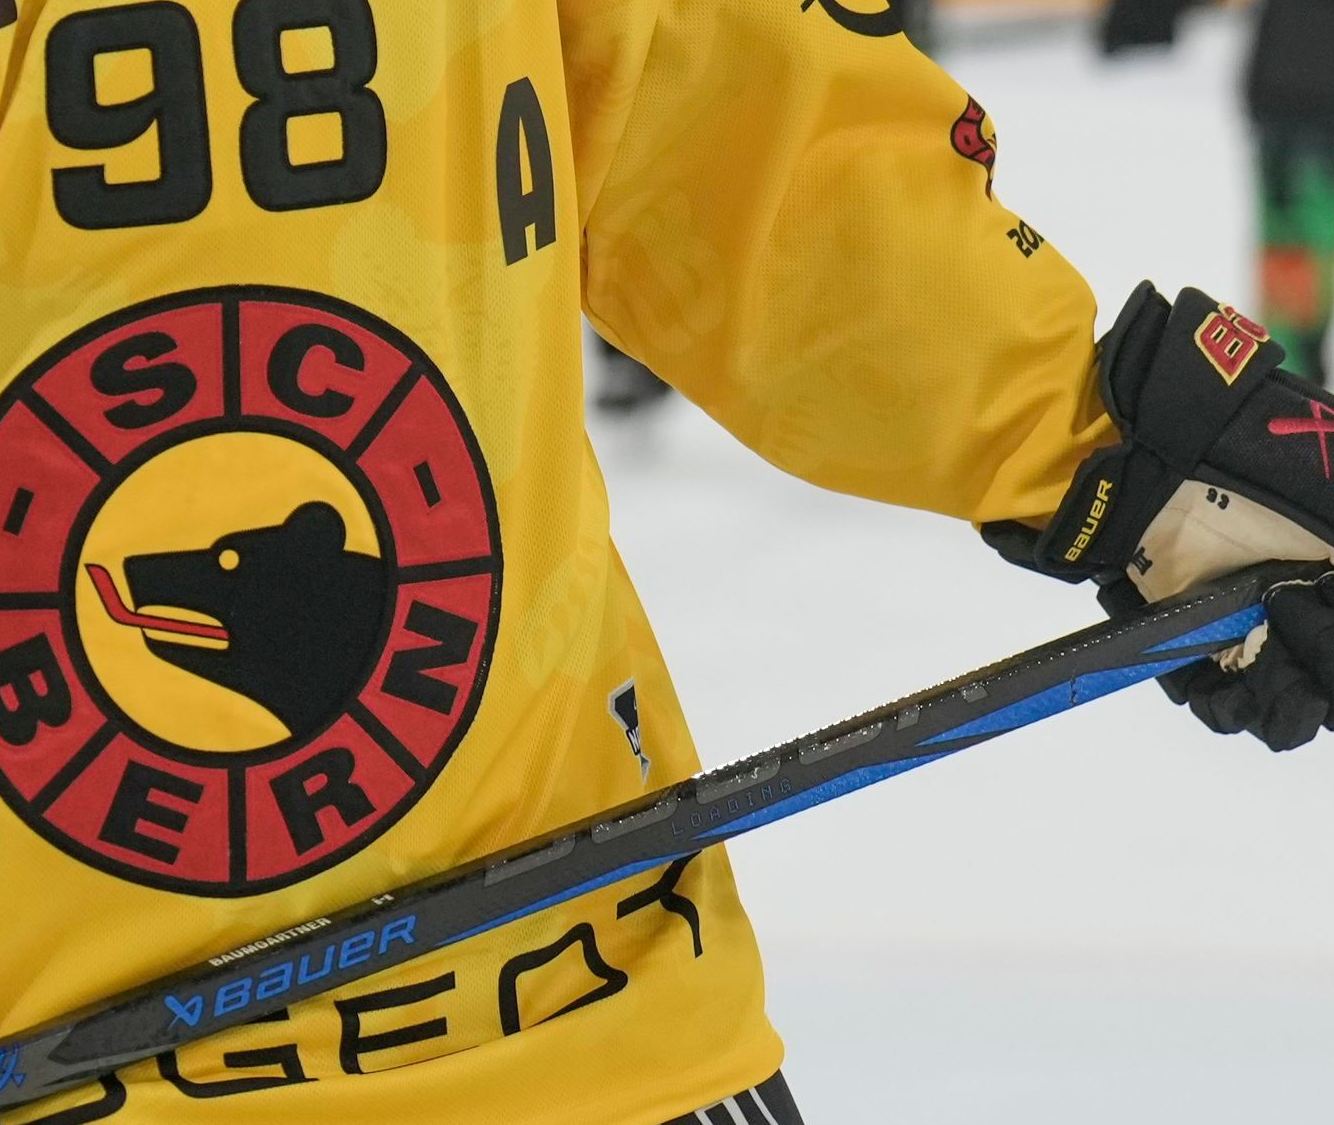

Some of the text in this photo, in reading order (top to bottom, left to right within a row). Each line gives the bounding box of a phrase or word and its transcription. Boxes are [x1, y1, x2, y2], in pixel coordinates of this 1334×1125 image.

[496, 76, 557, 267] A
[89, 322, 366, 430] SC
[672, 778, 792, 835] LOADING
[208, 917, 332, 967] BAUMGARTNER
